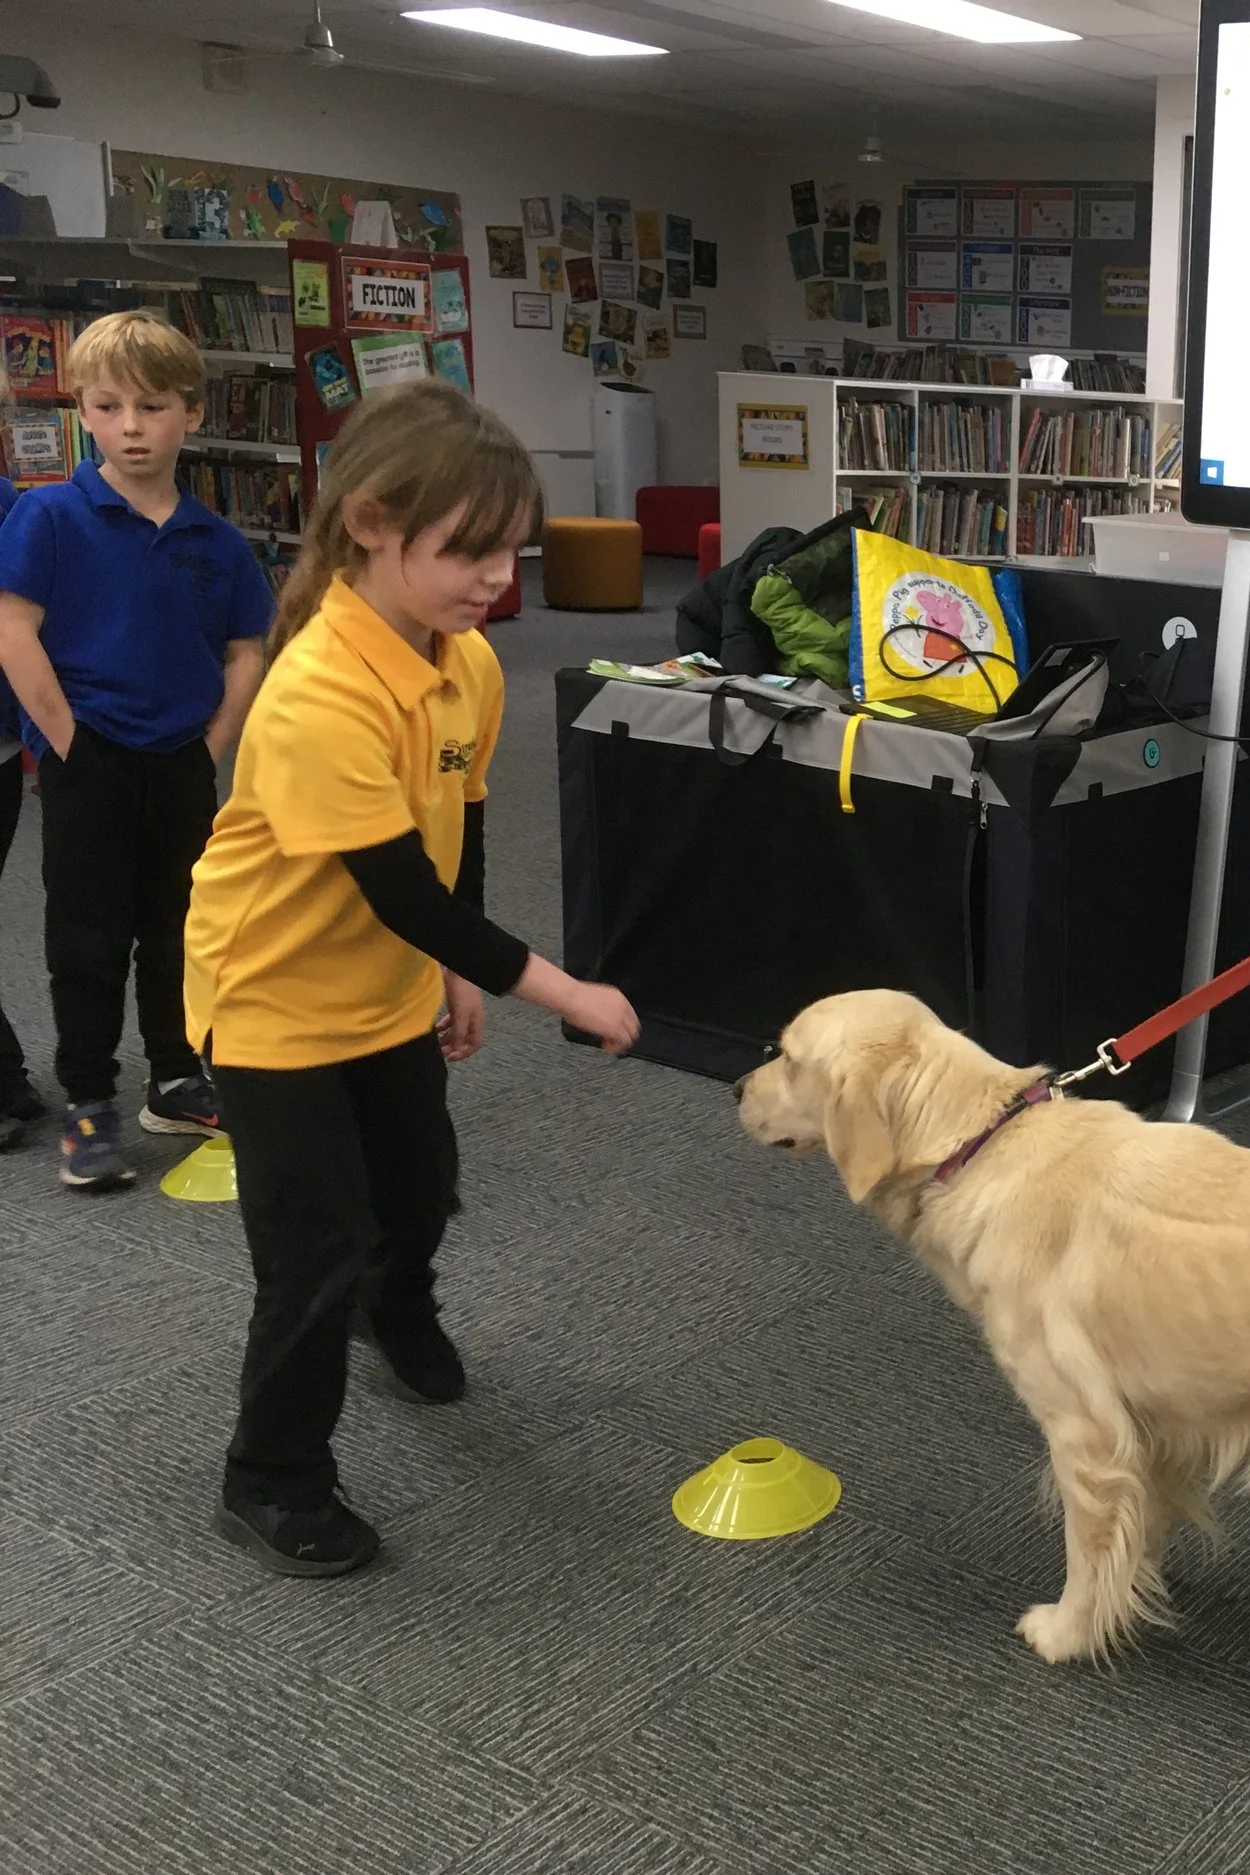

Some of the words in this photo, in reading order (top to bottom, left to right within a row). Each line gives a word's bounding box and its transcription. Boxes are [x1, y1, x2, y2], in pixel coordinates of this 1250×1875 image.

[362, 283, 416, 309] FICTION
[892, 588, 910, 599] Pig
[948, 585, 984, 620] Daffodil
[889, 602, 900, 630] Peppa
[975, 620, 989, 641] Day
